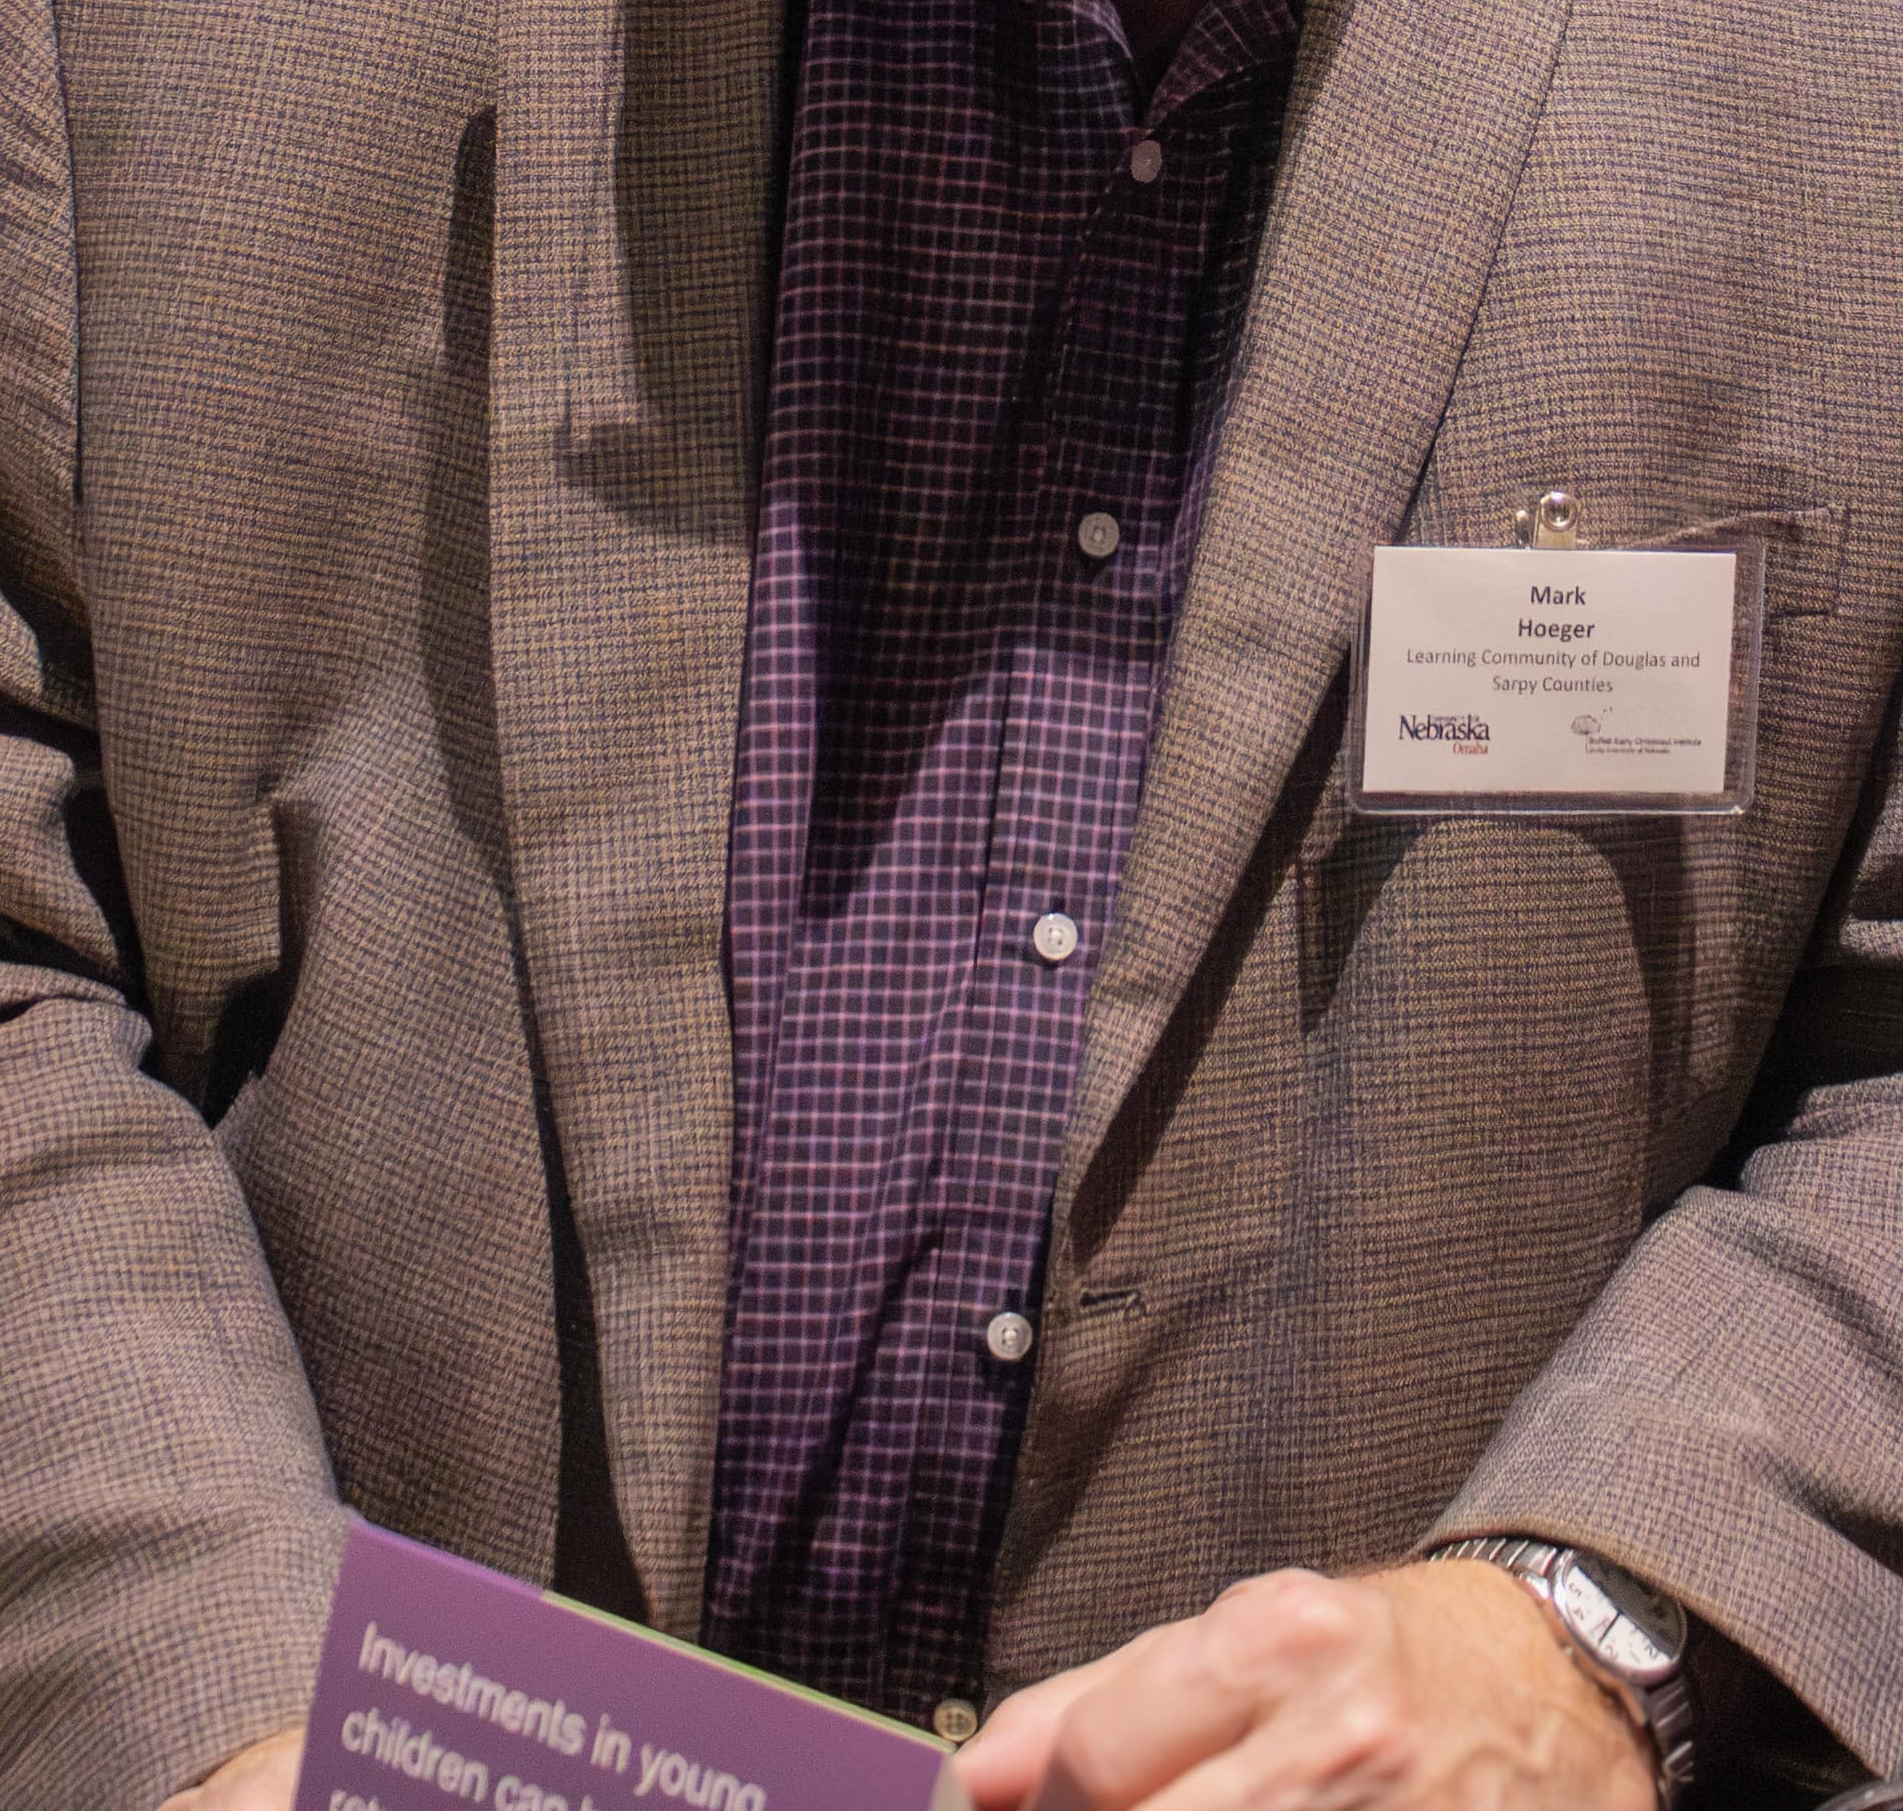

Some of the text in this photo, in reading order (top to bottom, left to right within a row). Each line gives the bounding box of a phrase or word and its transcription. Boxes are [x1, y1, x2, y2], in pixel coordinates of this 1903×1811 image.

[1530, 585, 1586, 606] Mark
[1518, 618, 1595, 643] Hoeger
[1406, 648, 1701, 670] Learning Community of Douglas and
[1492, 675, 1614, 695] Sarpy Counties
[1399, 714, 1491, 740] Nebraska
[358, 1621, 587, 1755] Investments
[590, 1712, 633, 1773] in
[341, 1707, 490, 1802] children
